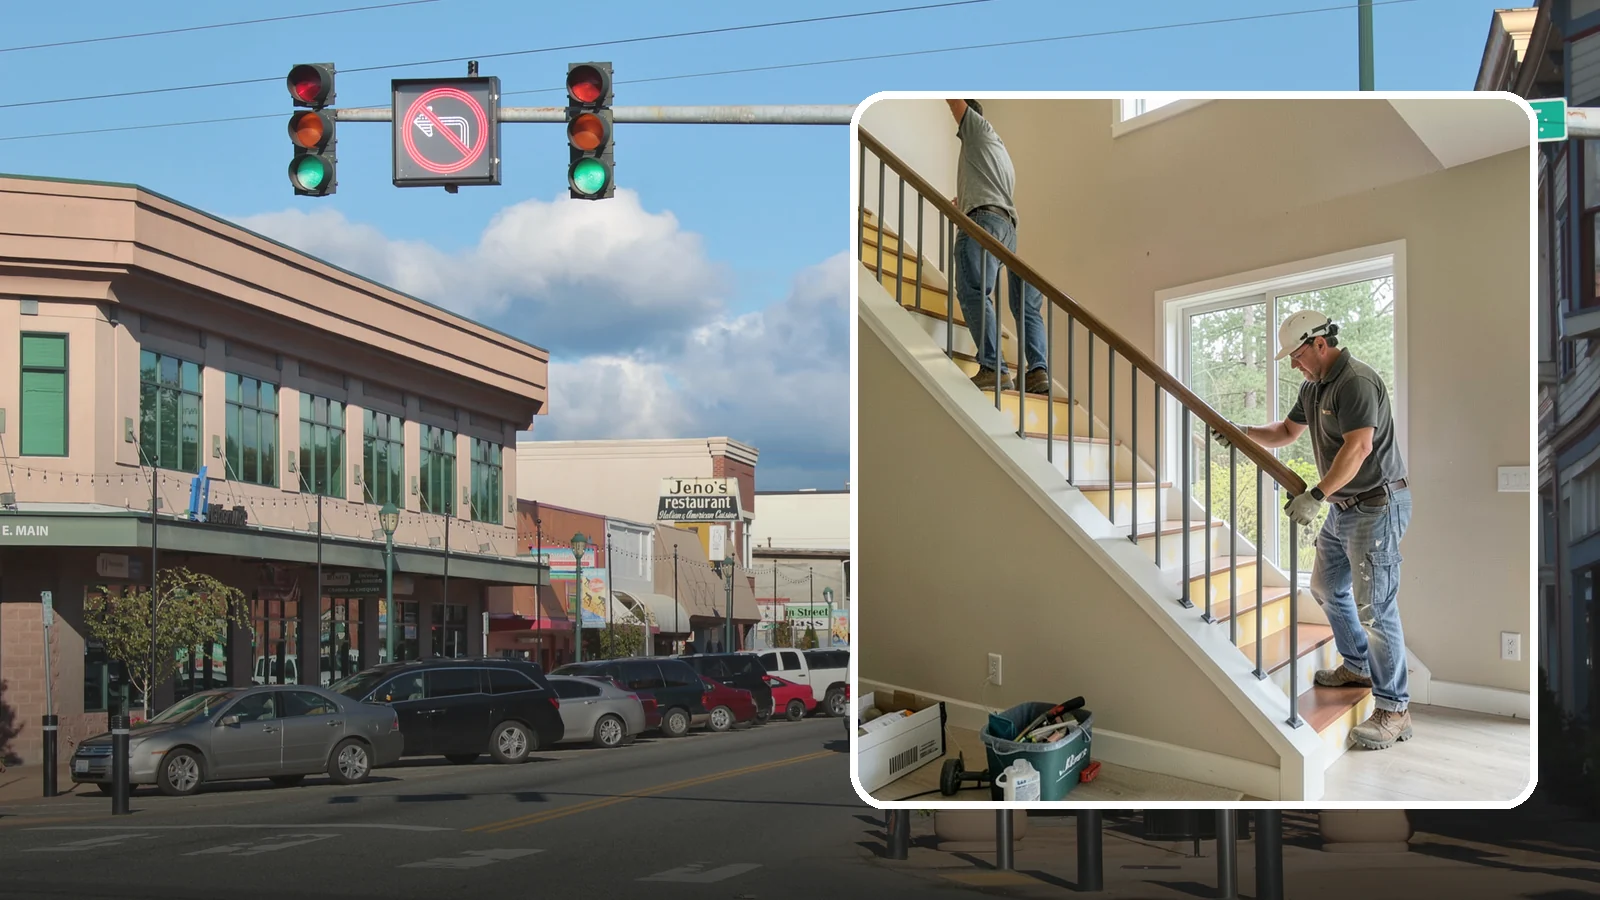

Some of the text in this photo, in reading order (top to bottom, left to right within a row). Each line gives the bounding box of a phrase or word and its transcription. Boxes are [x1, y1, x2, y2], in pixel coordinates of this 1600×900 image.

[670, 480, 727, 494] Jeno's
[665, 496, 731, 509] restaurant
[659, 510, 681, 519] Italian
[686, 510, 714, 519] American
[715, 510, 737, 519] Cuisine
[2, 525, 49, 536] E. MAIN
[797, 607, 828, 617] Street
